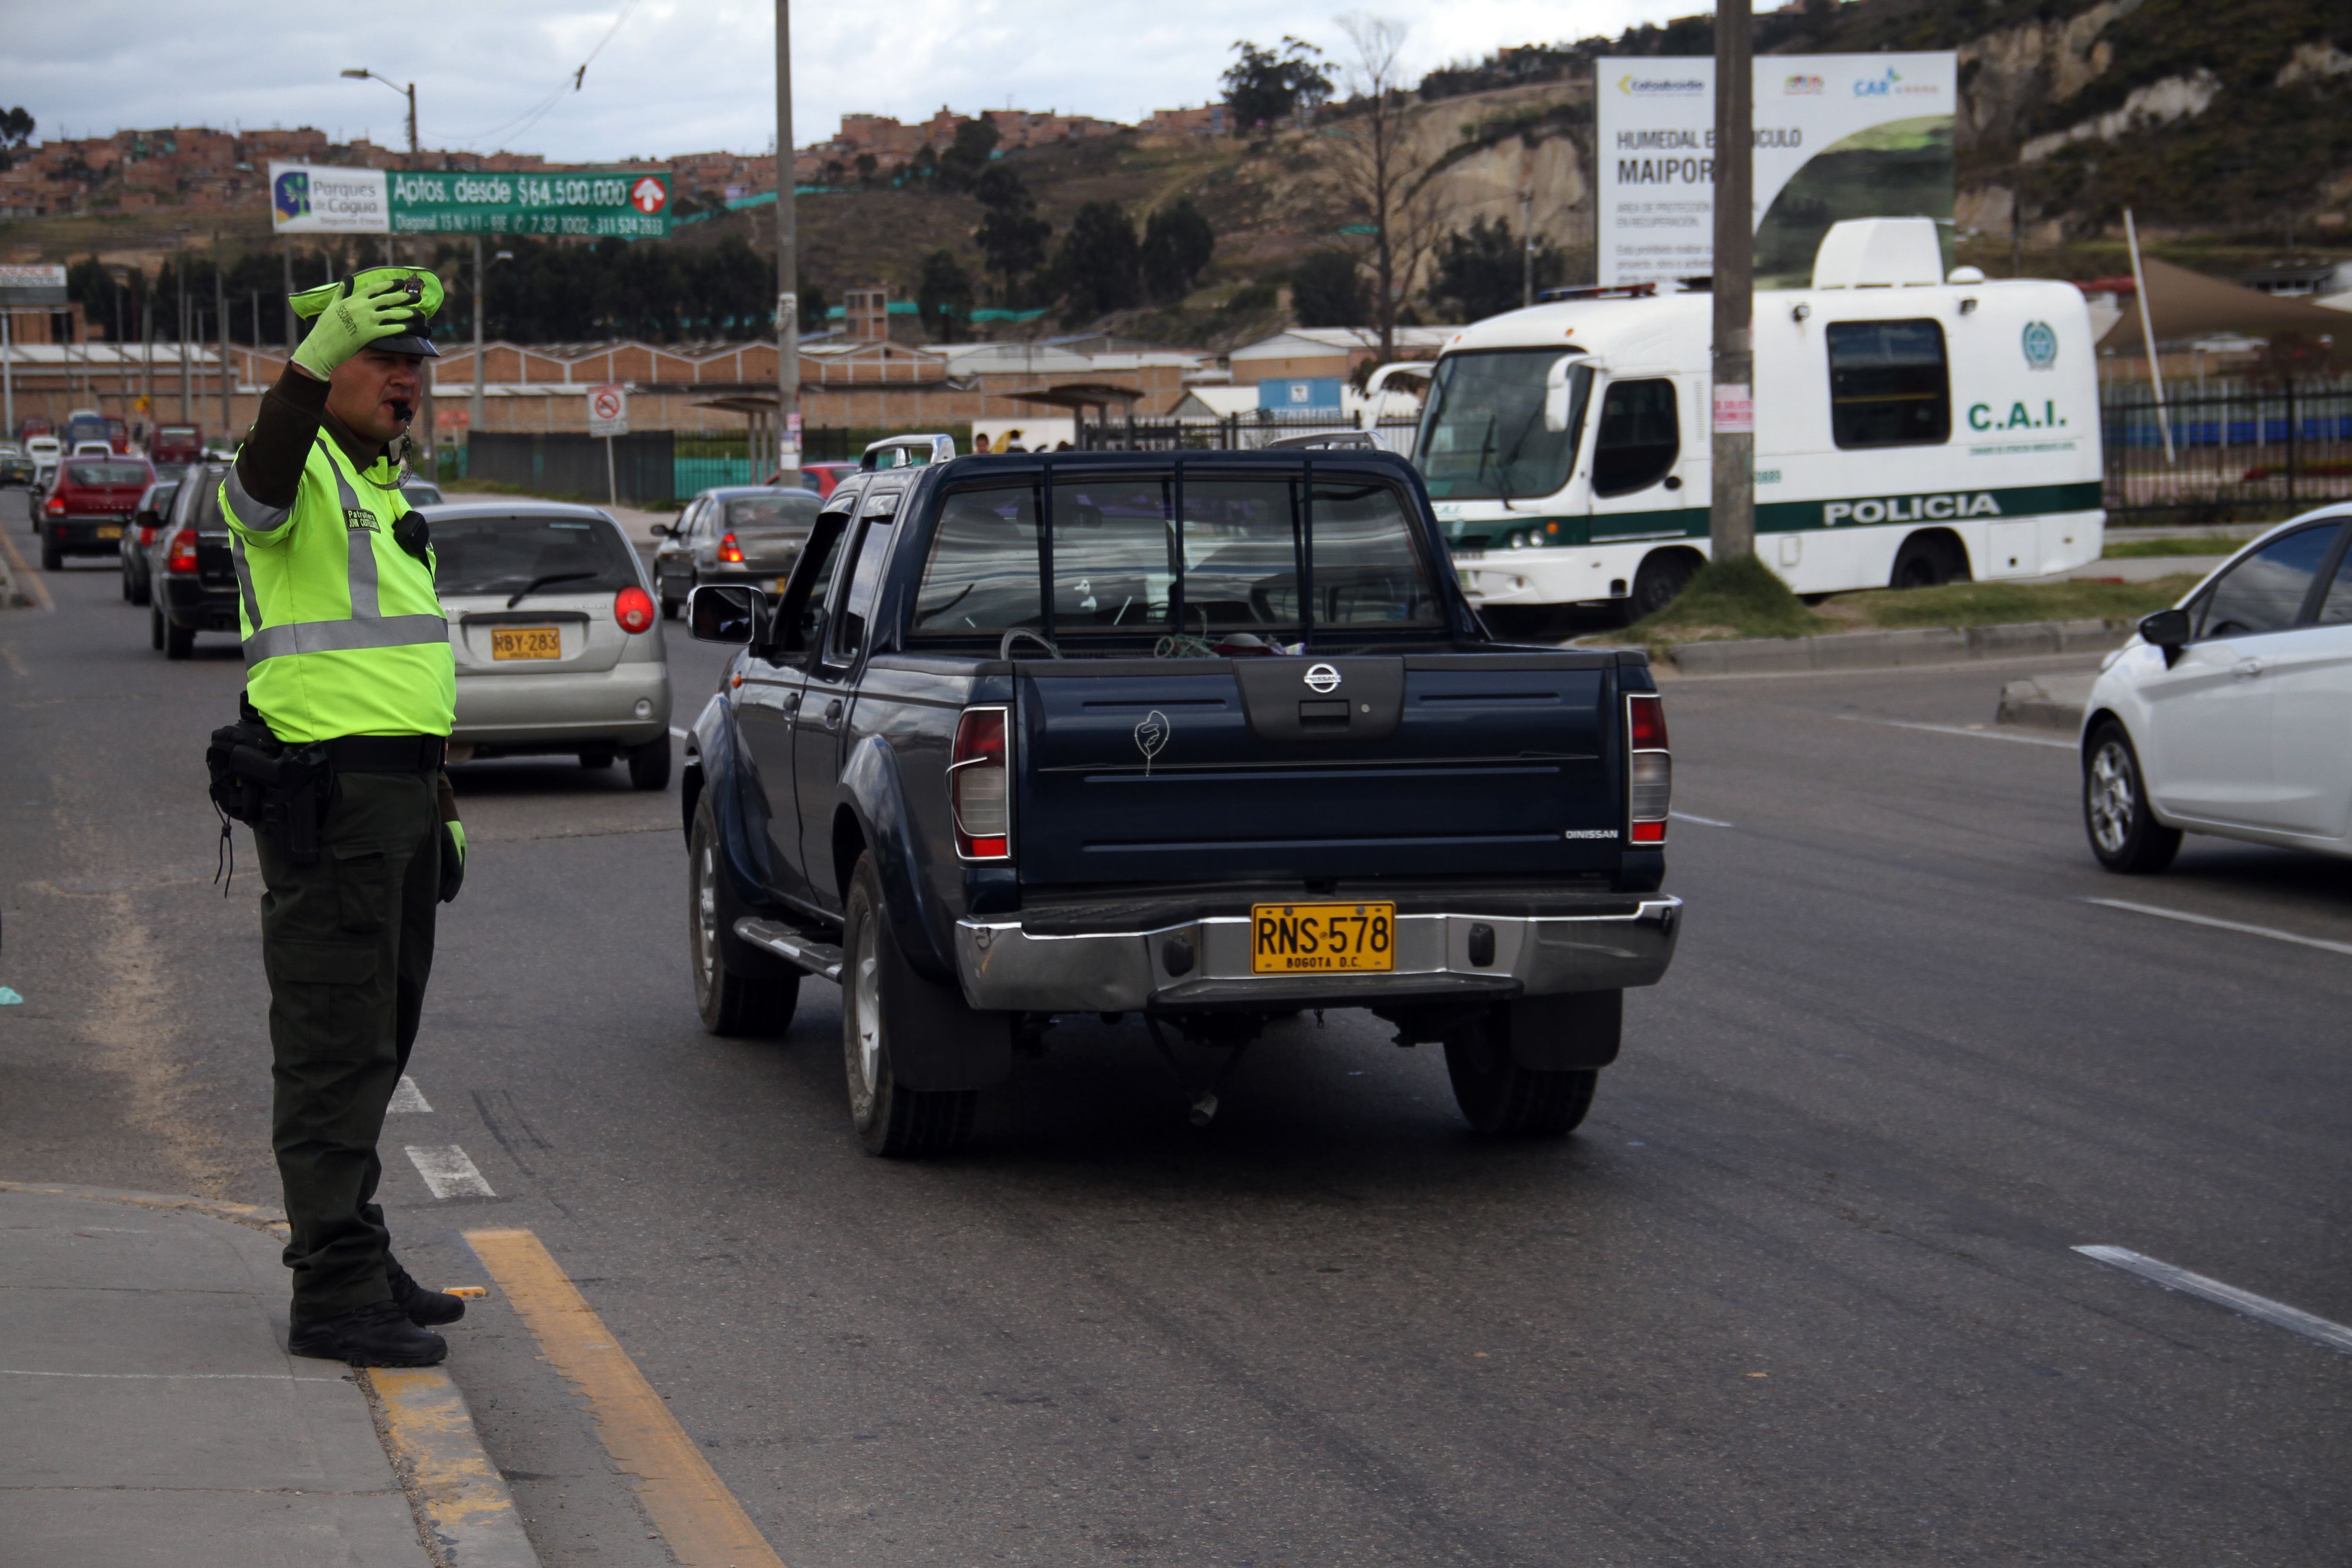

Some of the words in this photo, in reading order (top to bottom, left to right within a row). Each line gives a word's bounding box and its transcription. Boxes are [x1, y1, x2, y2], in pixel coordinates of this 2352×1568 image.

[1854, 80, 1888, 94] CAR
[1618, 129, 1700, 149] HUMEDAL
[1705, 129, 1716, 149] E
[1753, 127, 1802, 148] CULO
[1618, 157, 1716, 184] MAIPOR
[314, 180, 376, 199] Parques
[394, 174, 450, 207] Aptos.
[454, 175, 511, 203] desde
[518, 175, 626, 207] $64.500.000
[328, 198, 377, 217] Cogua
[395, 213, 437, 233] Diagonal
[335, 305, 358, 337] SECURITY
[1968, 399, 2067, 431] C.A.I.
[1823, 493, 2002, 526] POLICIA
[529, 635, 558, 651] 283
[1565, 830, 1619, 839] DINISSAN
[1258, 917, 1319, 955] RNS
[1328, 916, 1389, 954] 578
[1287, 957, 1331, 968] BOGOTA
[1339, 956, 1361, 968] D.C.
